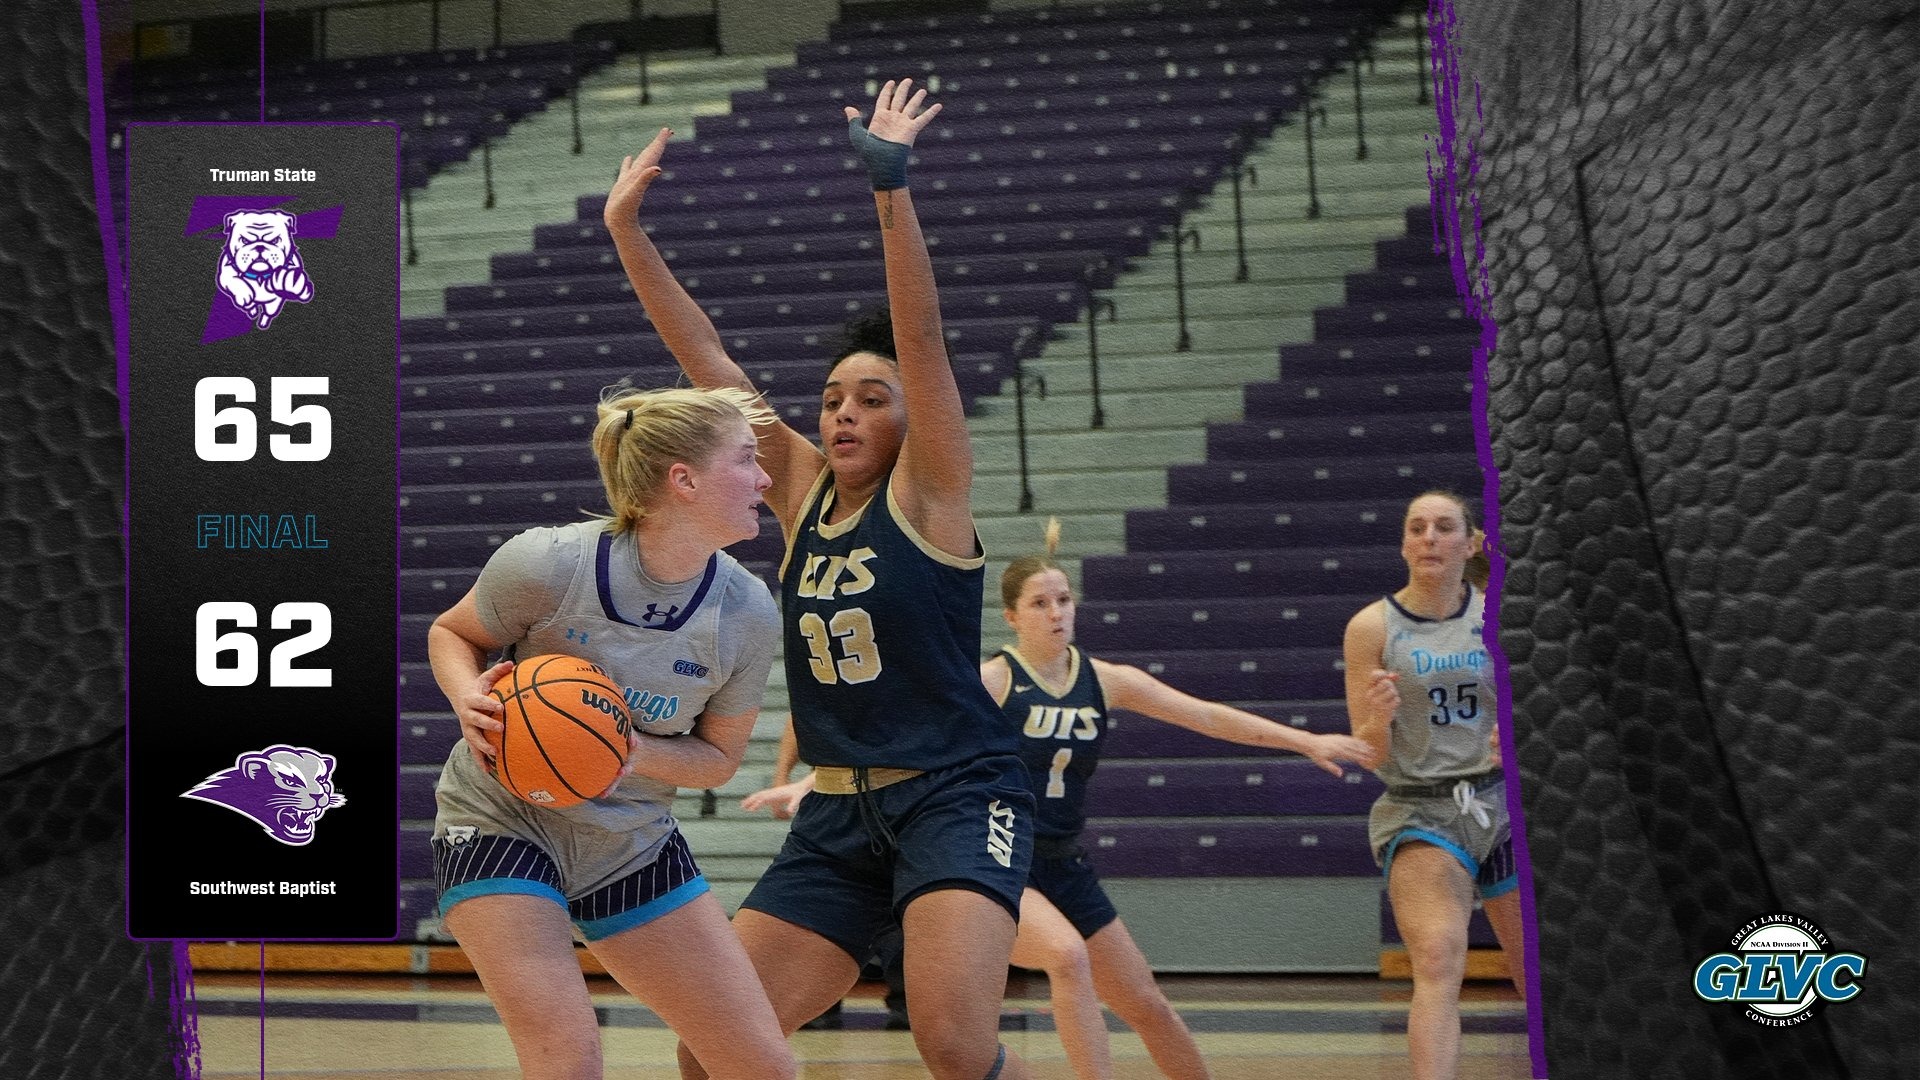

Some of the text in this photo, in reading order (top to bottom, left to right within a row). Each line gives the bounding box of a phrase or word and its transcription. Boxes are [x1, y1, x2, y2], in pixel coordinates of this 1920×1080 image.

[798, 607, 882, 685] 33
[673, 660, 709, 678] GLVC
[581, 688, 631, 739] ilson
[624, 687, 679, 723] wgs
[1023, 704, 1100, 741] UIS
[1428, 683, 1478, 725] 35
[1045, 747, 1073, 799] 1
